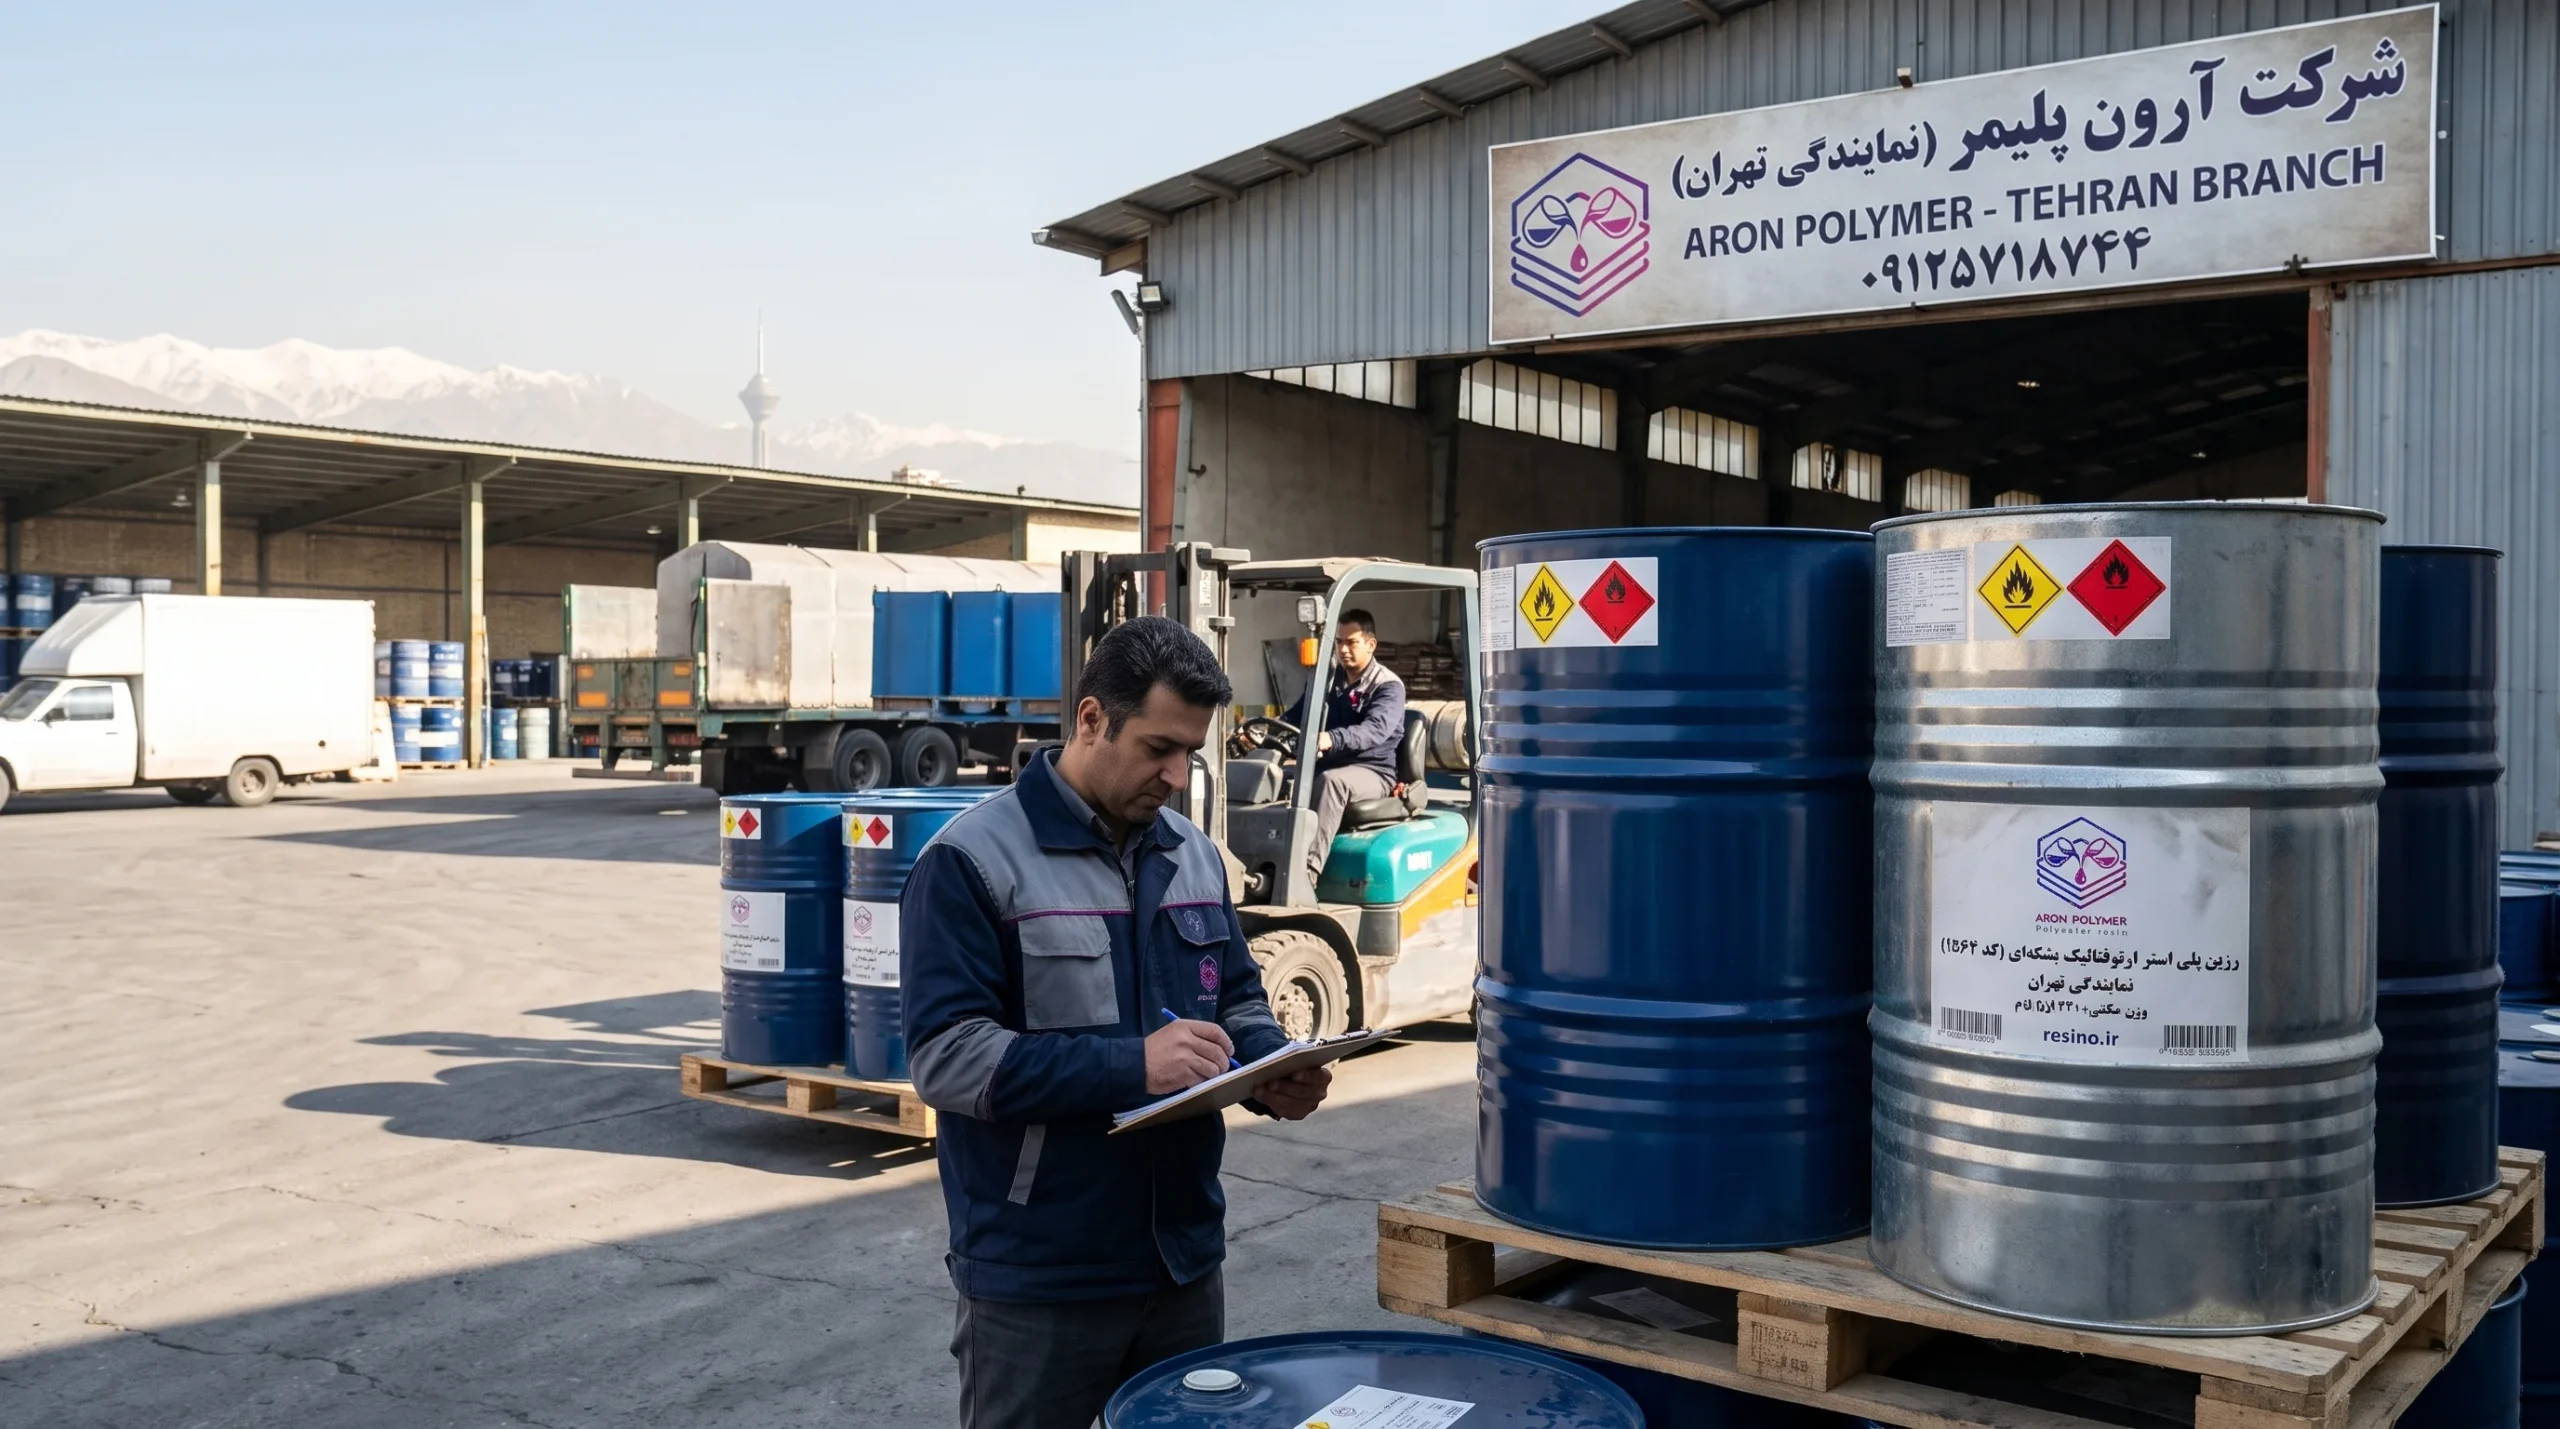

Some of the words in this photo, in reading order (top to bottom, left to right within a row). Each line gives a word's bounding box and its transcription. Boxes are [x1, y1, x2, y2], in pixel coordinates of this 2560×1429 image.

[2084, 57, 2225, 151] آرون
[2240, 37, 2406, 123] شرکت
[1777, 121, 1937, 187] (نمایندگی
[1949, 89, 2069, 171] پلیمر
[1672, 146, 1768, 199] تهران)
[1683, 217, 1783, 260] ARON
[1796, 194, 1973, 247] POLYMER
[2006, 170, 2179, 223] TEHRAN
[2193, 144, 2385, 203] BRANCH
[1861, 227, 2152, 293] ۰۹۱۲۵۷۱۸۷۴۴
[2035, 913, 2068, 924] ARON
[2072, 915, 2128, 926] POLYMER
[2142, 950, 2173, 970] استر
[2043, 1028, 2119, 1046] resino.ir
